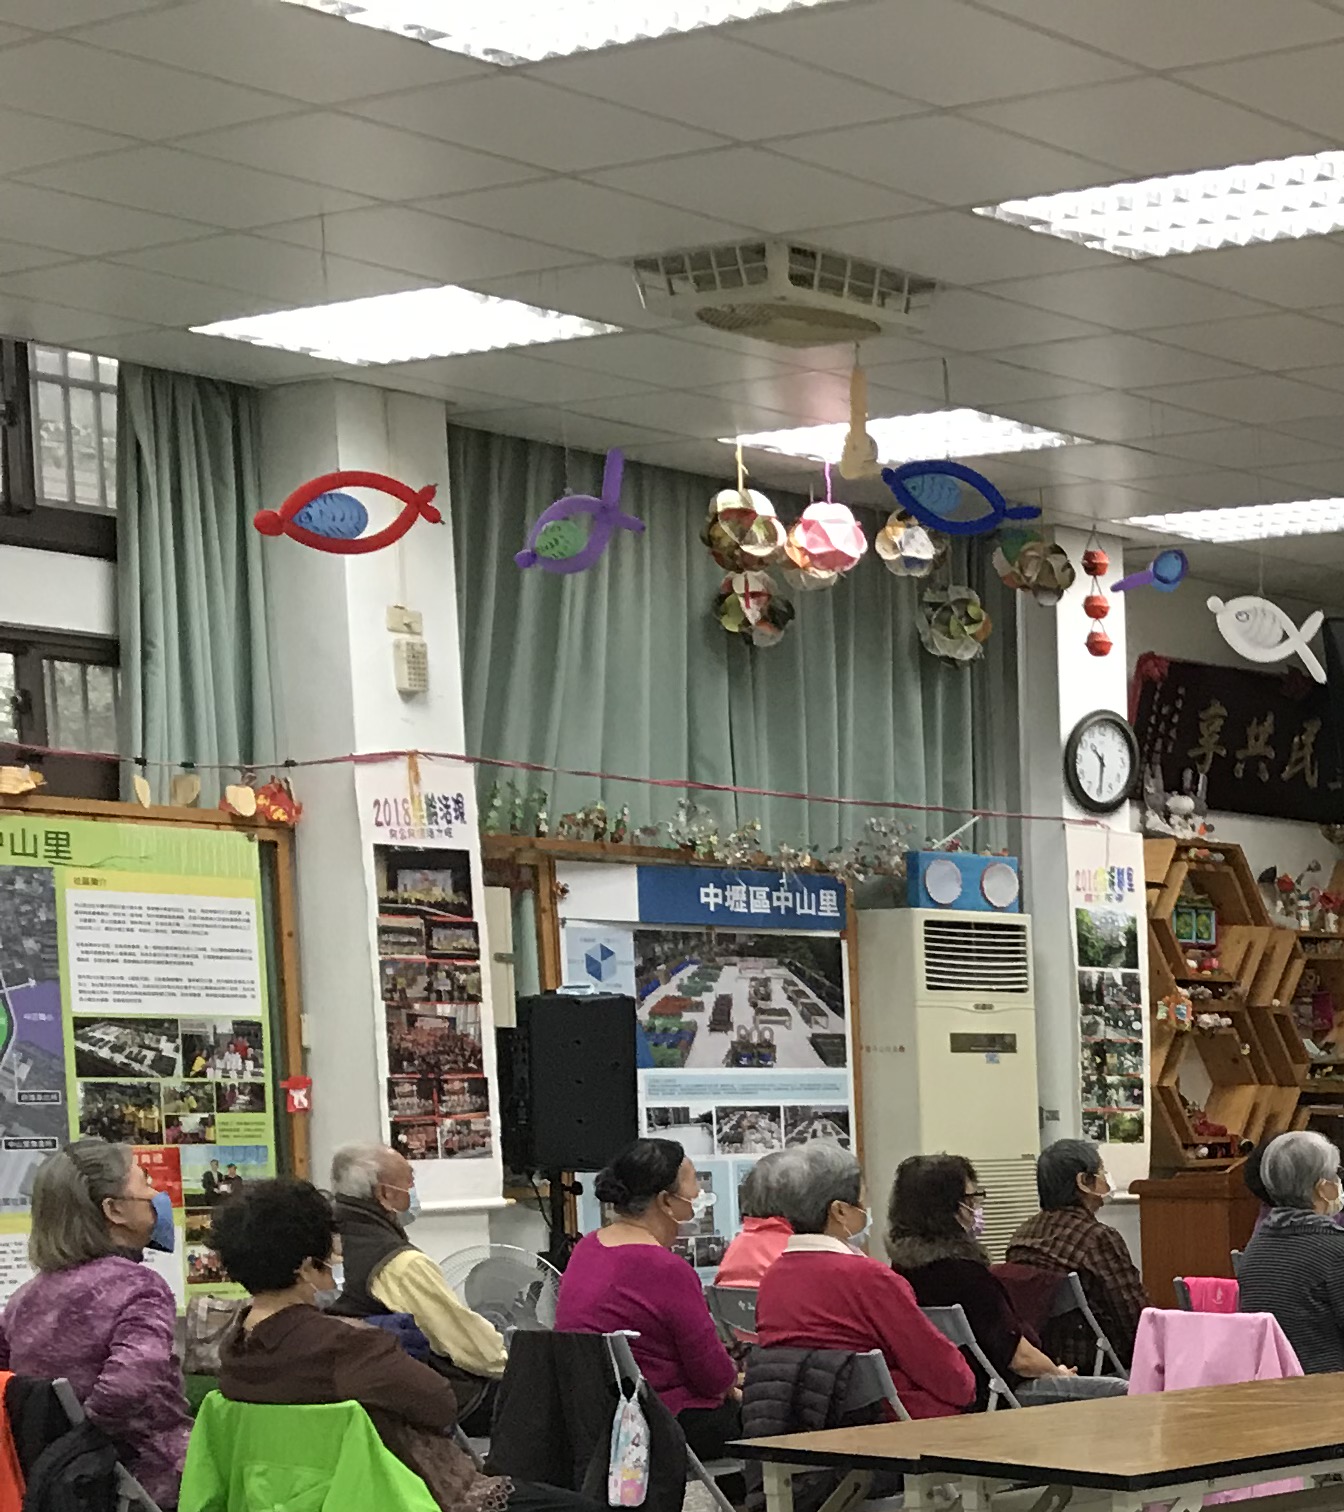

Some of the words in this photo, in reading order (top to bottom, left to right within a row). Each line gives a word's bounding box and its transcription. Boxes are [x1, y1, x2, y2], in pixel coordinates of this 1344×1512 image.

[0, 828, 73, 860] 山里
[699, 882, 840, 917] 中壢區中山里
